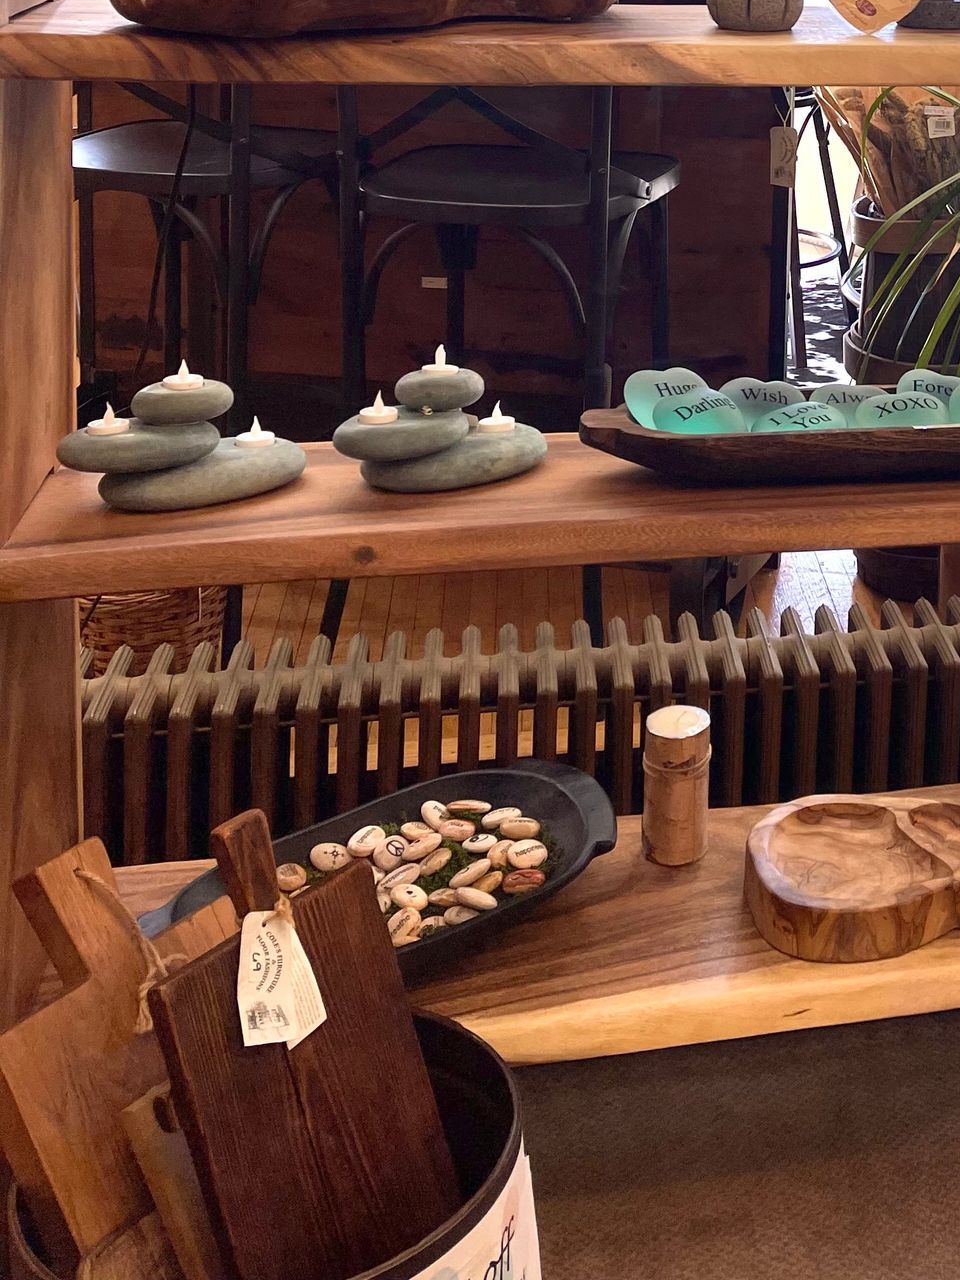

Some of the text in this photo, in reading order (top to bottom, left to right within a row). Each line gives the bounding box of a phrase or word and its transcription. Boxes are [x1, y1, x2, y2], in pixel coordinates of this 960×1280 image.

[741, 388, 789, 405] Wish
[673, 394, 735, 422] Darling
[769, 402, 829, 426] I Love
[875, 397, 939, 419] XOXO
[792, 413, 832, 430] You
